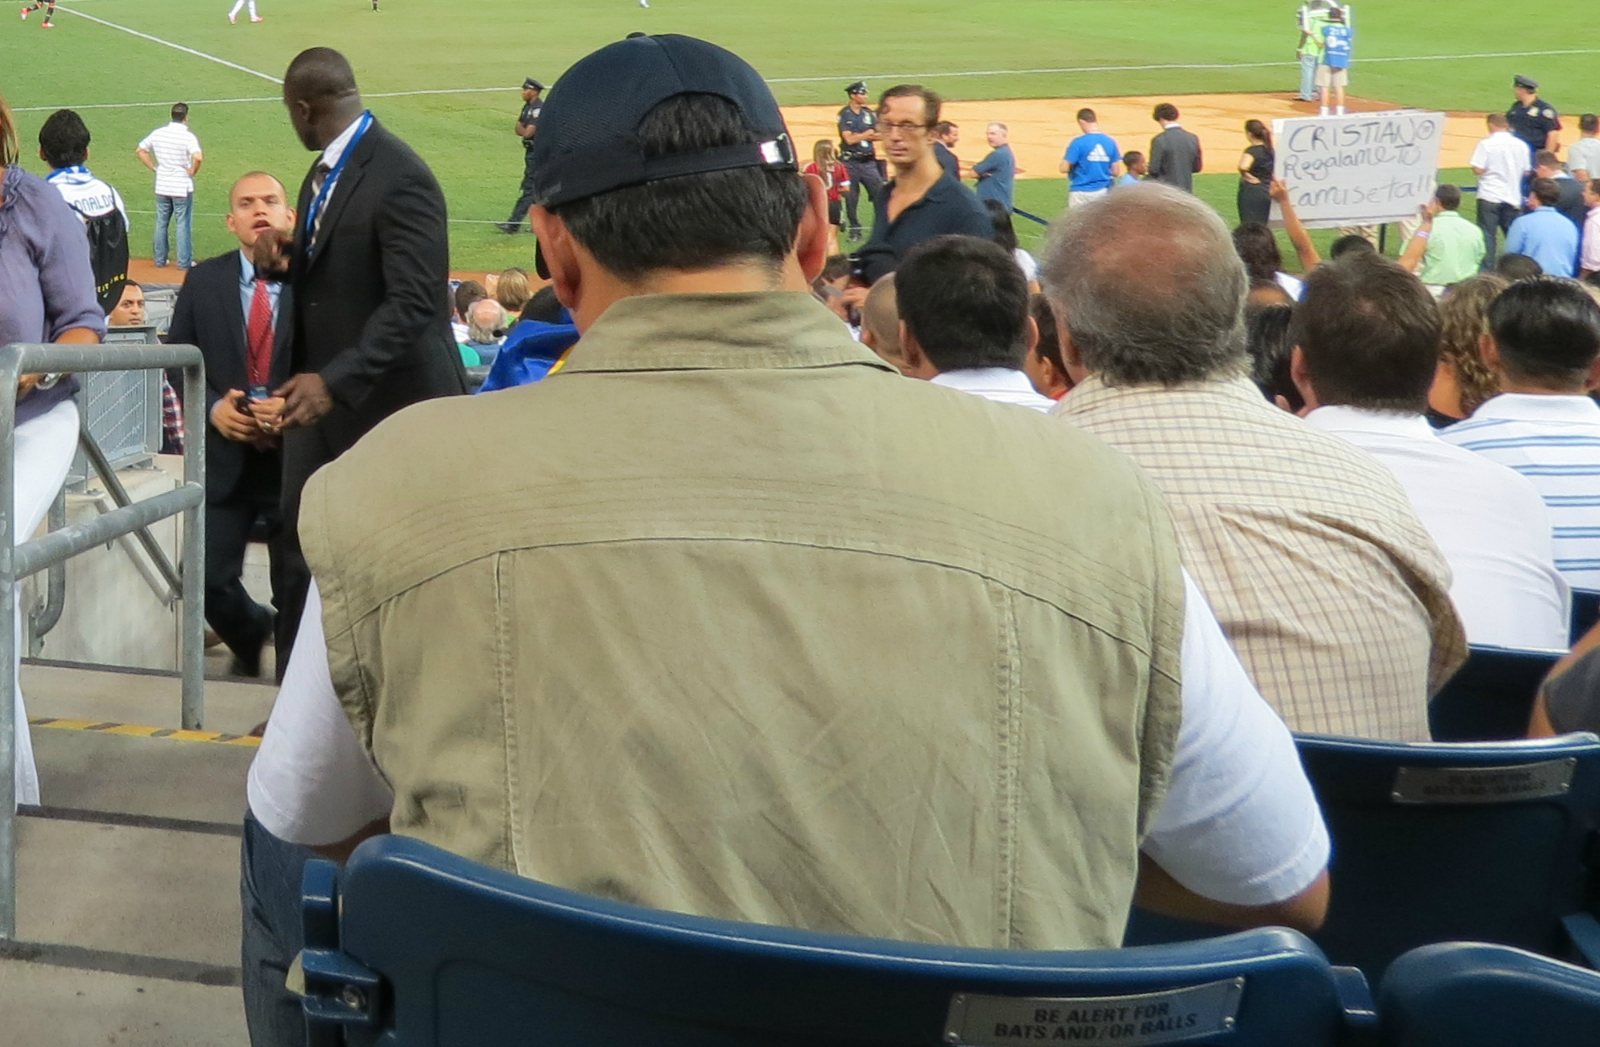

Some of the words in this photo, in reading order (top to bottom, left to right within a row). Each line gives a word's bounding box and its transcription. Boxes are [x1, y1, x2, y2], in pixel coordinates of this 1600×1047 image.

[1288, 117, 1435, 153] CRISTIANO
[1284, 145, 1395, 181] Regalame
[994, 1022, 1047, 1040] BATS
[1140, 1013, 1197, 1036] BALLS
[1033, 1008, 1059, 1023] BE
[1066, 1005, 1127, 1024] ALERT
[1133, 1003, 1171, 1019] FOR
